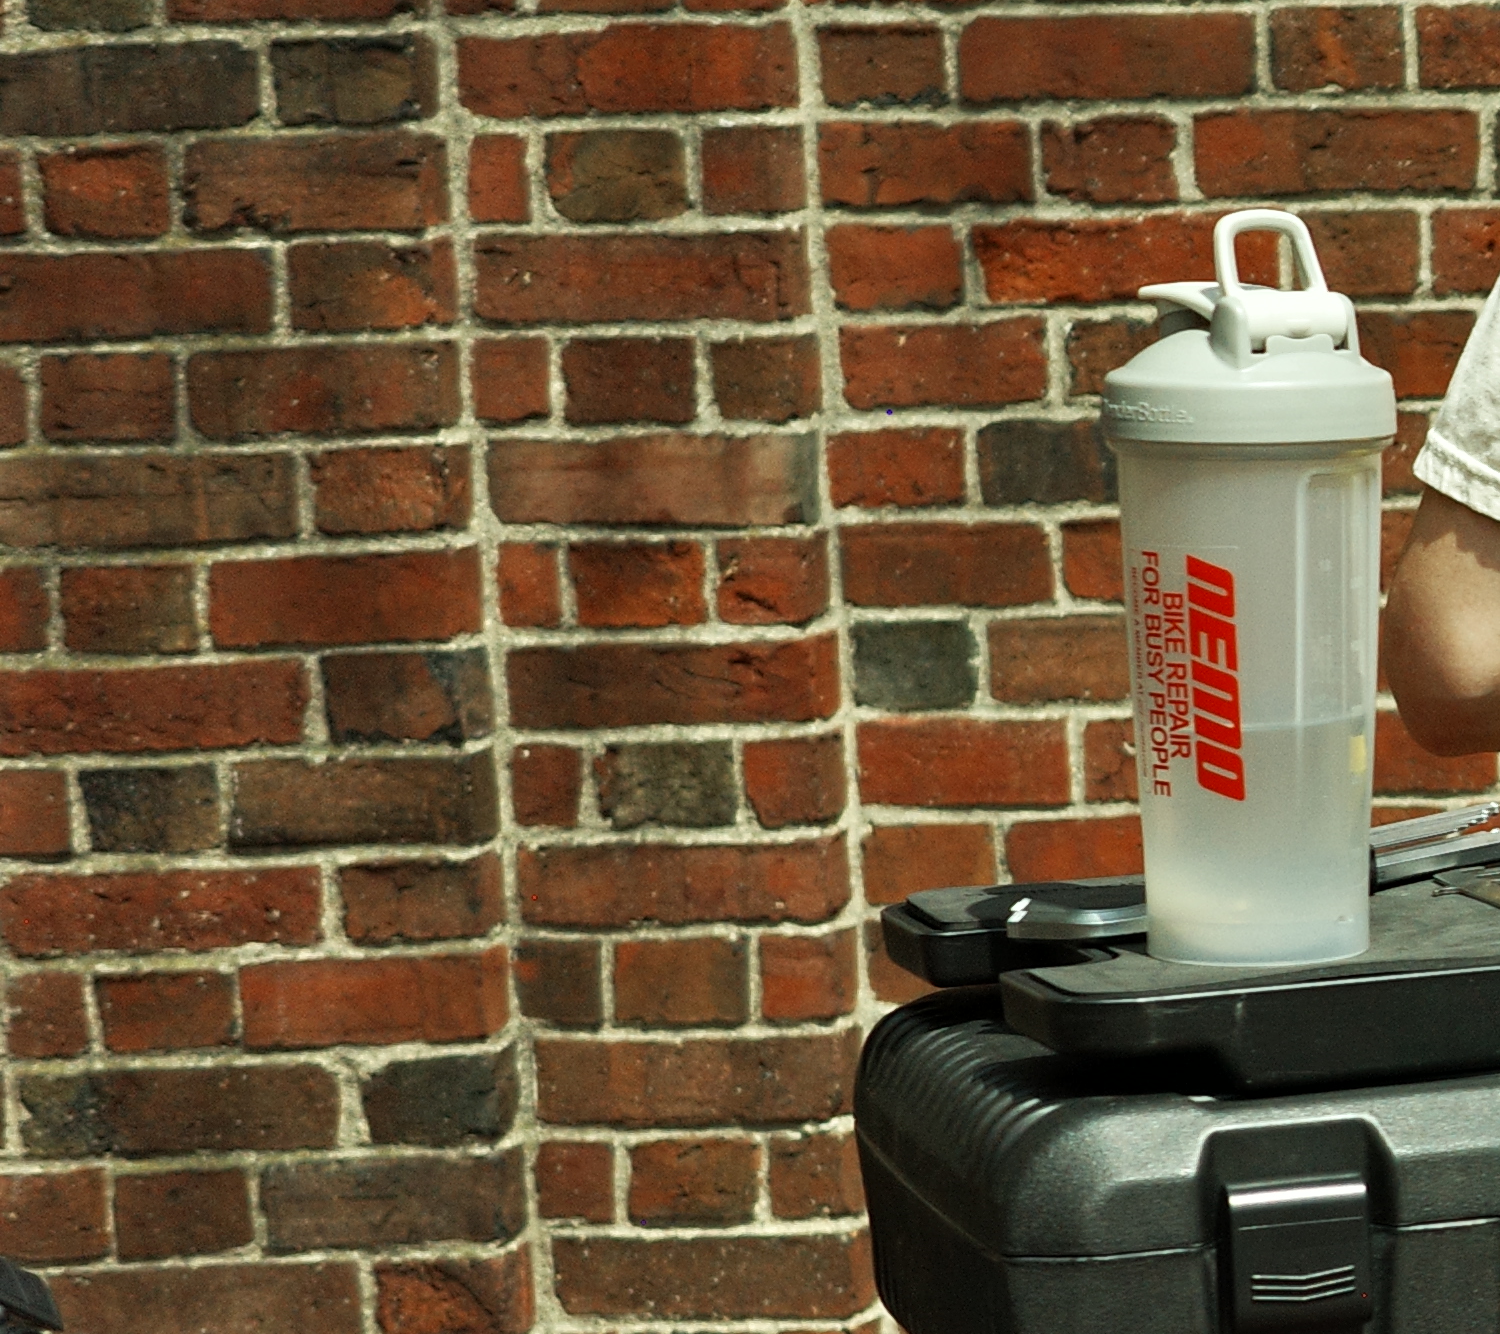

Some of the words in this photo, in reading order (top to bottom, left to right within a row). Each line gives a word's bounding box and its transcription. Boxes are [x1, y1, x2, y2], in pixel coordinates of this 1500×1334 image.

[1142, 551, 1160, 606] FOR
[1144, 614, 1164, 685] BUSY
[1162, 593, 1186, 654] BIKE
[1166, 662, 1191, 759] REPAIR
[1185, 554, 1246, 802] NEMO
[1149, 693, 1172, 798] PEOPLE
